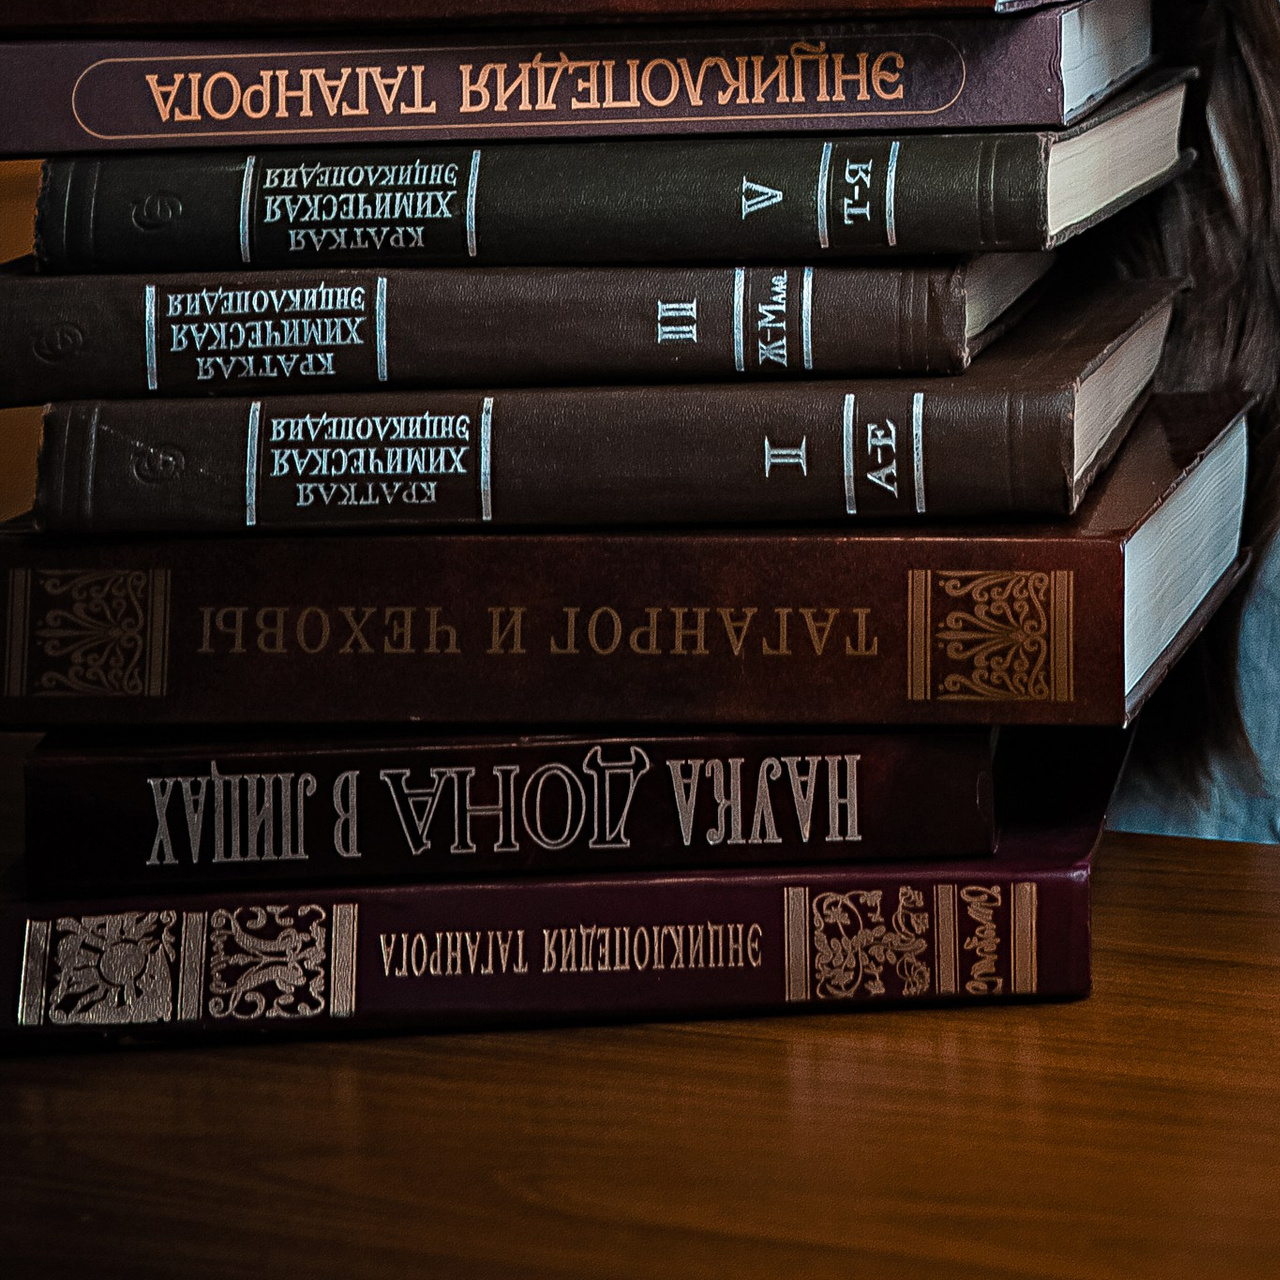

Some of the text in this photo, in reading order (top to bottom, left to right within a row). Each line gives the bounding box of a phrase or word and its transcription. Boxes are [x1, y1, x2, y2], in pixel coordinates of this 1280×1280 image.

[145, 42, 905, 123] ЭНЦИКЛОПЕДИЯ ТАГАНРОГА
[263, 158, 459, 189] ЭНЦИКЛОПЕДИЯ
[264, 190, 458, 223] ХИМИЧЕСКАЯ
[741, 175, 783, 220] V
[288, 226, 425, 252] КРАТКАЯ
[167, 281, 366, 316] ЭНЦИКЛОПЕДИЯ
[170, 316, 366, 352] ХИМИЧЕСКАЯ
[196, 352, 336, 380] КРАТКАЯ
[271, 411, 471, 441] ЭНЦИКЛОПЕДИЯ
[271, 446, 468, 476] ХИМИЧЕСКАЯ
[296, 481, 437, 507] КРАТКАЯ
[199, 606, 879, 657] ТАГАНРОГ И ЧЕХОВЫ
[145, 745, 863, 866] НАУКА ДОНА В ЛИЦАХ
[379, 921, 763, 977] ЭНЦИКЛОПЕДИЯ ТАГАНРОГА
